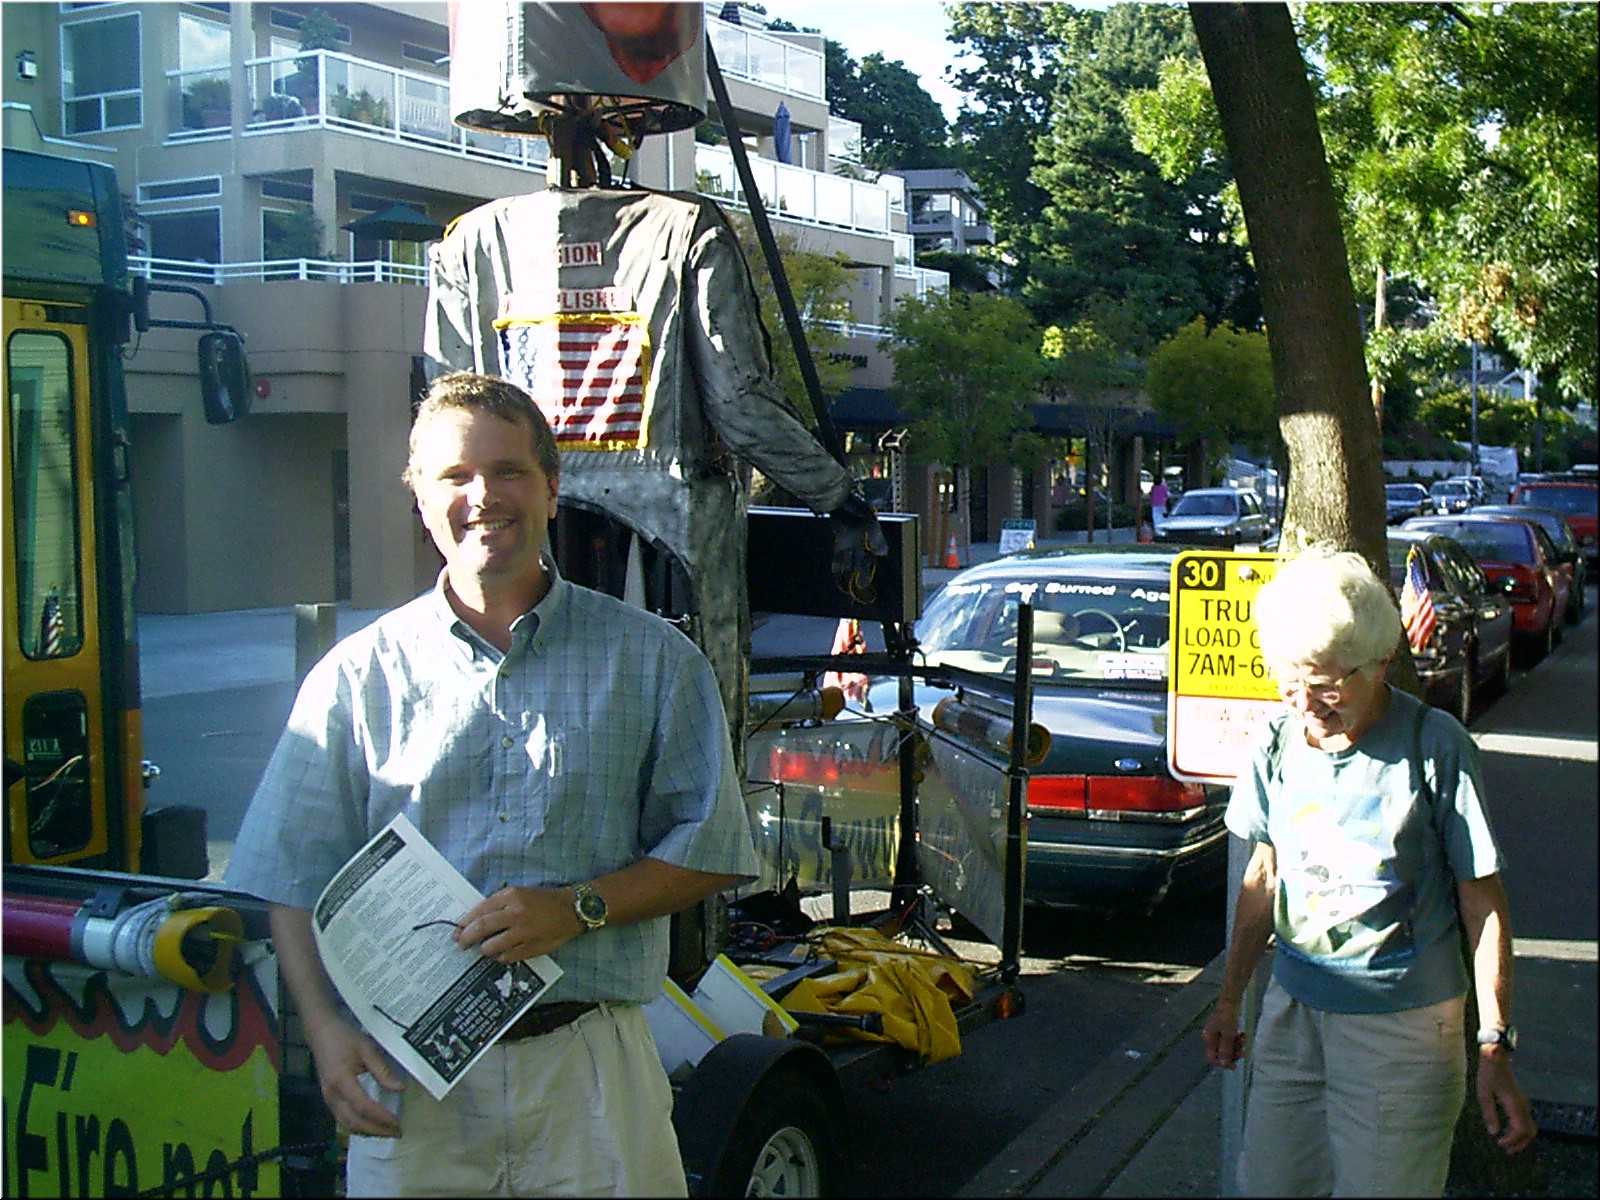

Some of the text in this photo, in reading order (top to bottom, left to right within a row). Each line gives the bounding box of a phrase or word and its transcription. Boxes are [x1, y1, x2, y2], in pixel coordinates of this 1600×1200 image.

[559, 245, 598, 264] ION
[1183, 560, 1219, 588] 30
[1045, 582, 1116, 596] Burned
[1131, 588, 1170, 602] Aga
[1200, 598, 1251, 623] TRU
[1184, 627, 1241, 648] LOAD
[1188, 652, 1272, 680] 7AM-6
